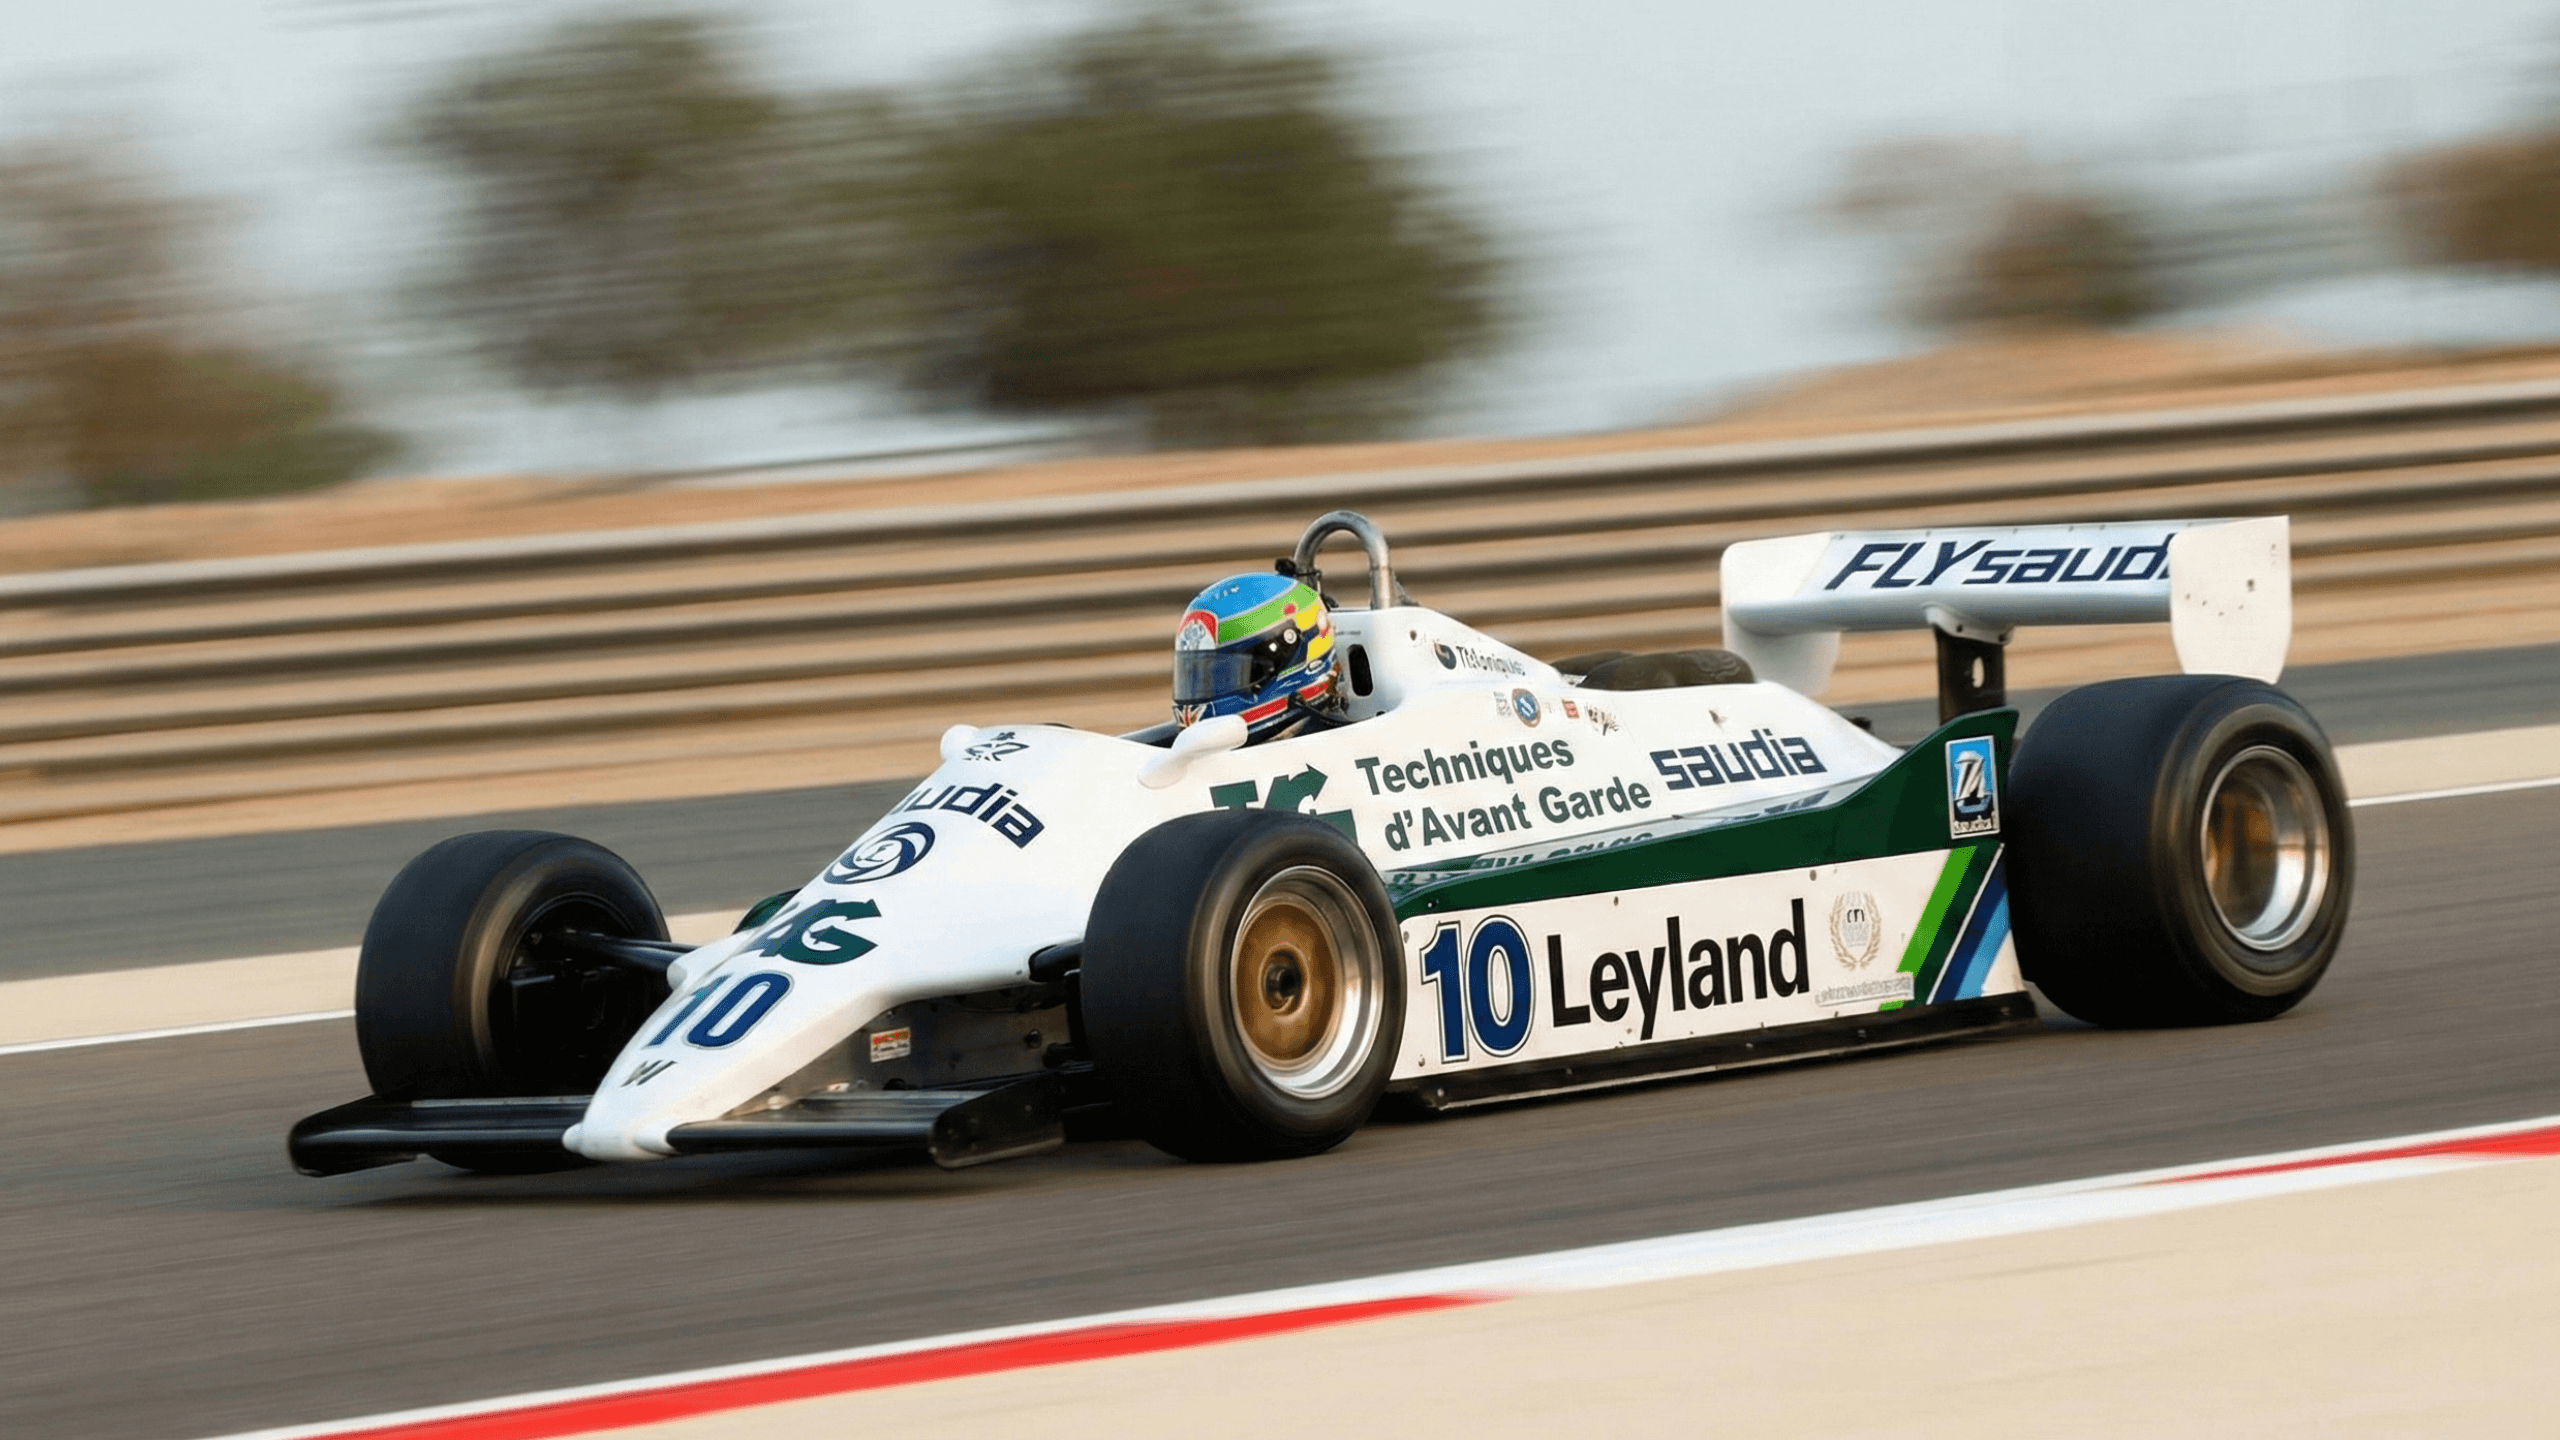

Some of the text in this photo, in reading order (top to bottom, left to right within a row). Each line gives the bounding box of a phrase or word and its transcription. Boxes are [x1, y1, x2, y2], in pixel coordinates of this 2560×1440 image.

[1354, 739, 1575, 796] Techniques
[1650, 728, 1828, 791] saudia
[1539, 777, 1652, 824] Garde
[1420, 914, 1536, 1063] 10
[1546, 898, 1810, 1040] Leyland
[645, 970, 793, 1049] 10
